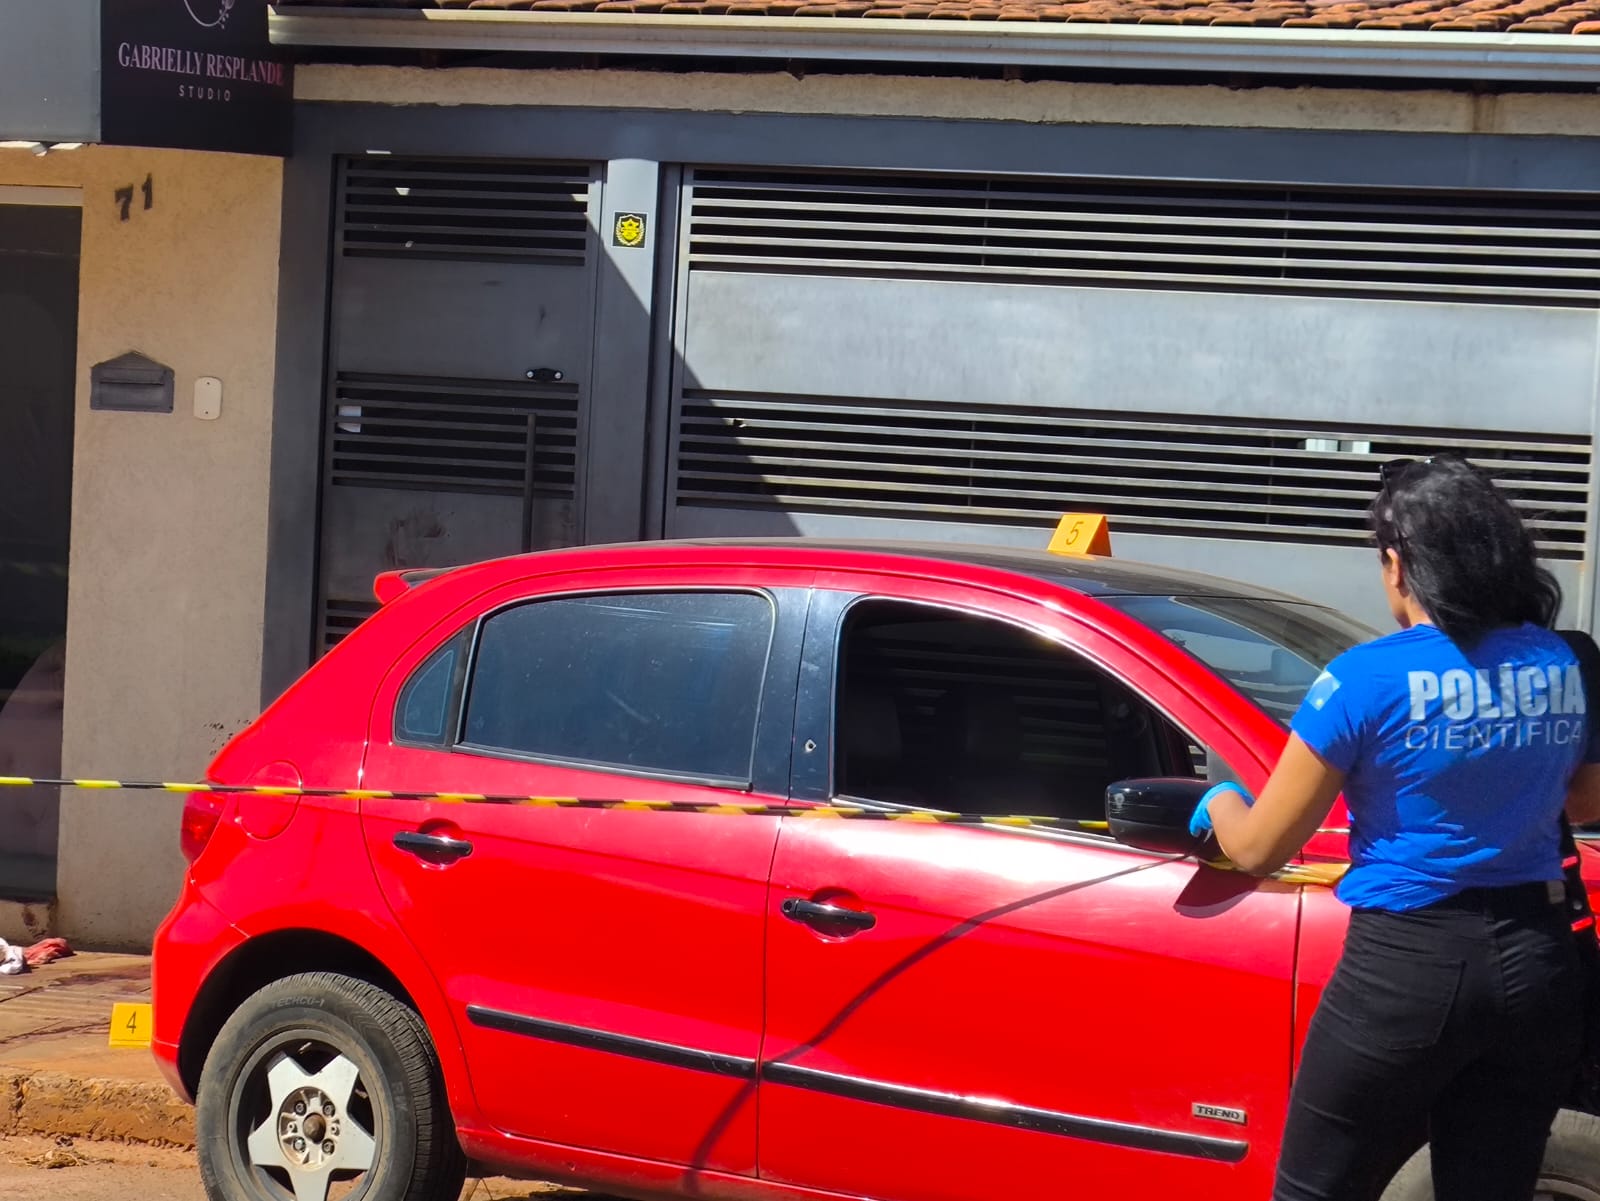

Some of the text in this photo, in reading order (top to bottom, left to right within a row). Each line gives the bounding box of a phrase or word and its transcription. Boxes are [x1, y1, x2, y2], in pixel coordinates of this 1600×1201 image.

[118, 42, 203, 75] GABRIELLY
[178, 84, 231, 101] STUDIO
[114, 172, 153, 221] 71
[1066, 521, 1084, 545] 5
[126, 1011, 137, 1034] 4
[1197, 1105, 1240, 1120] TREND
